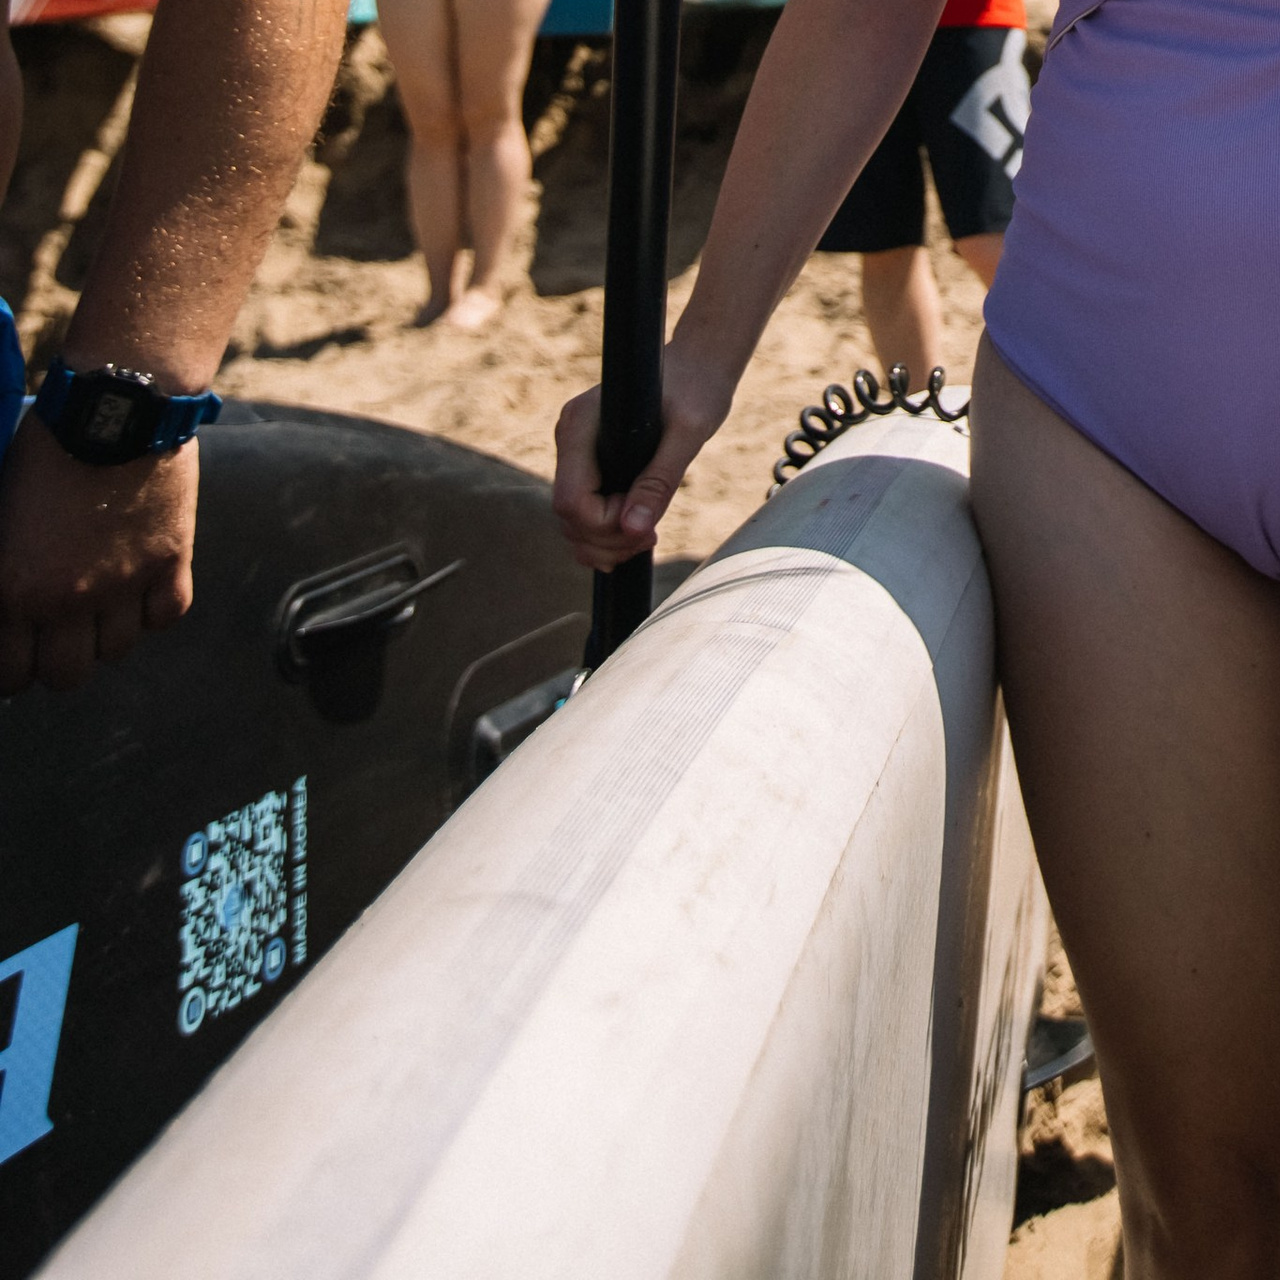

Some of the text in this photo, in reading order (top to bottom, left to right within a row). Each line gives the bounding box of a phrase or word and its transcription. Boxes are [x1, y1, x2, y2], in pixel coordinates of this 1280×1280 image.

[292, 774, 308, 965] MADE IN KOREA
